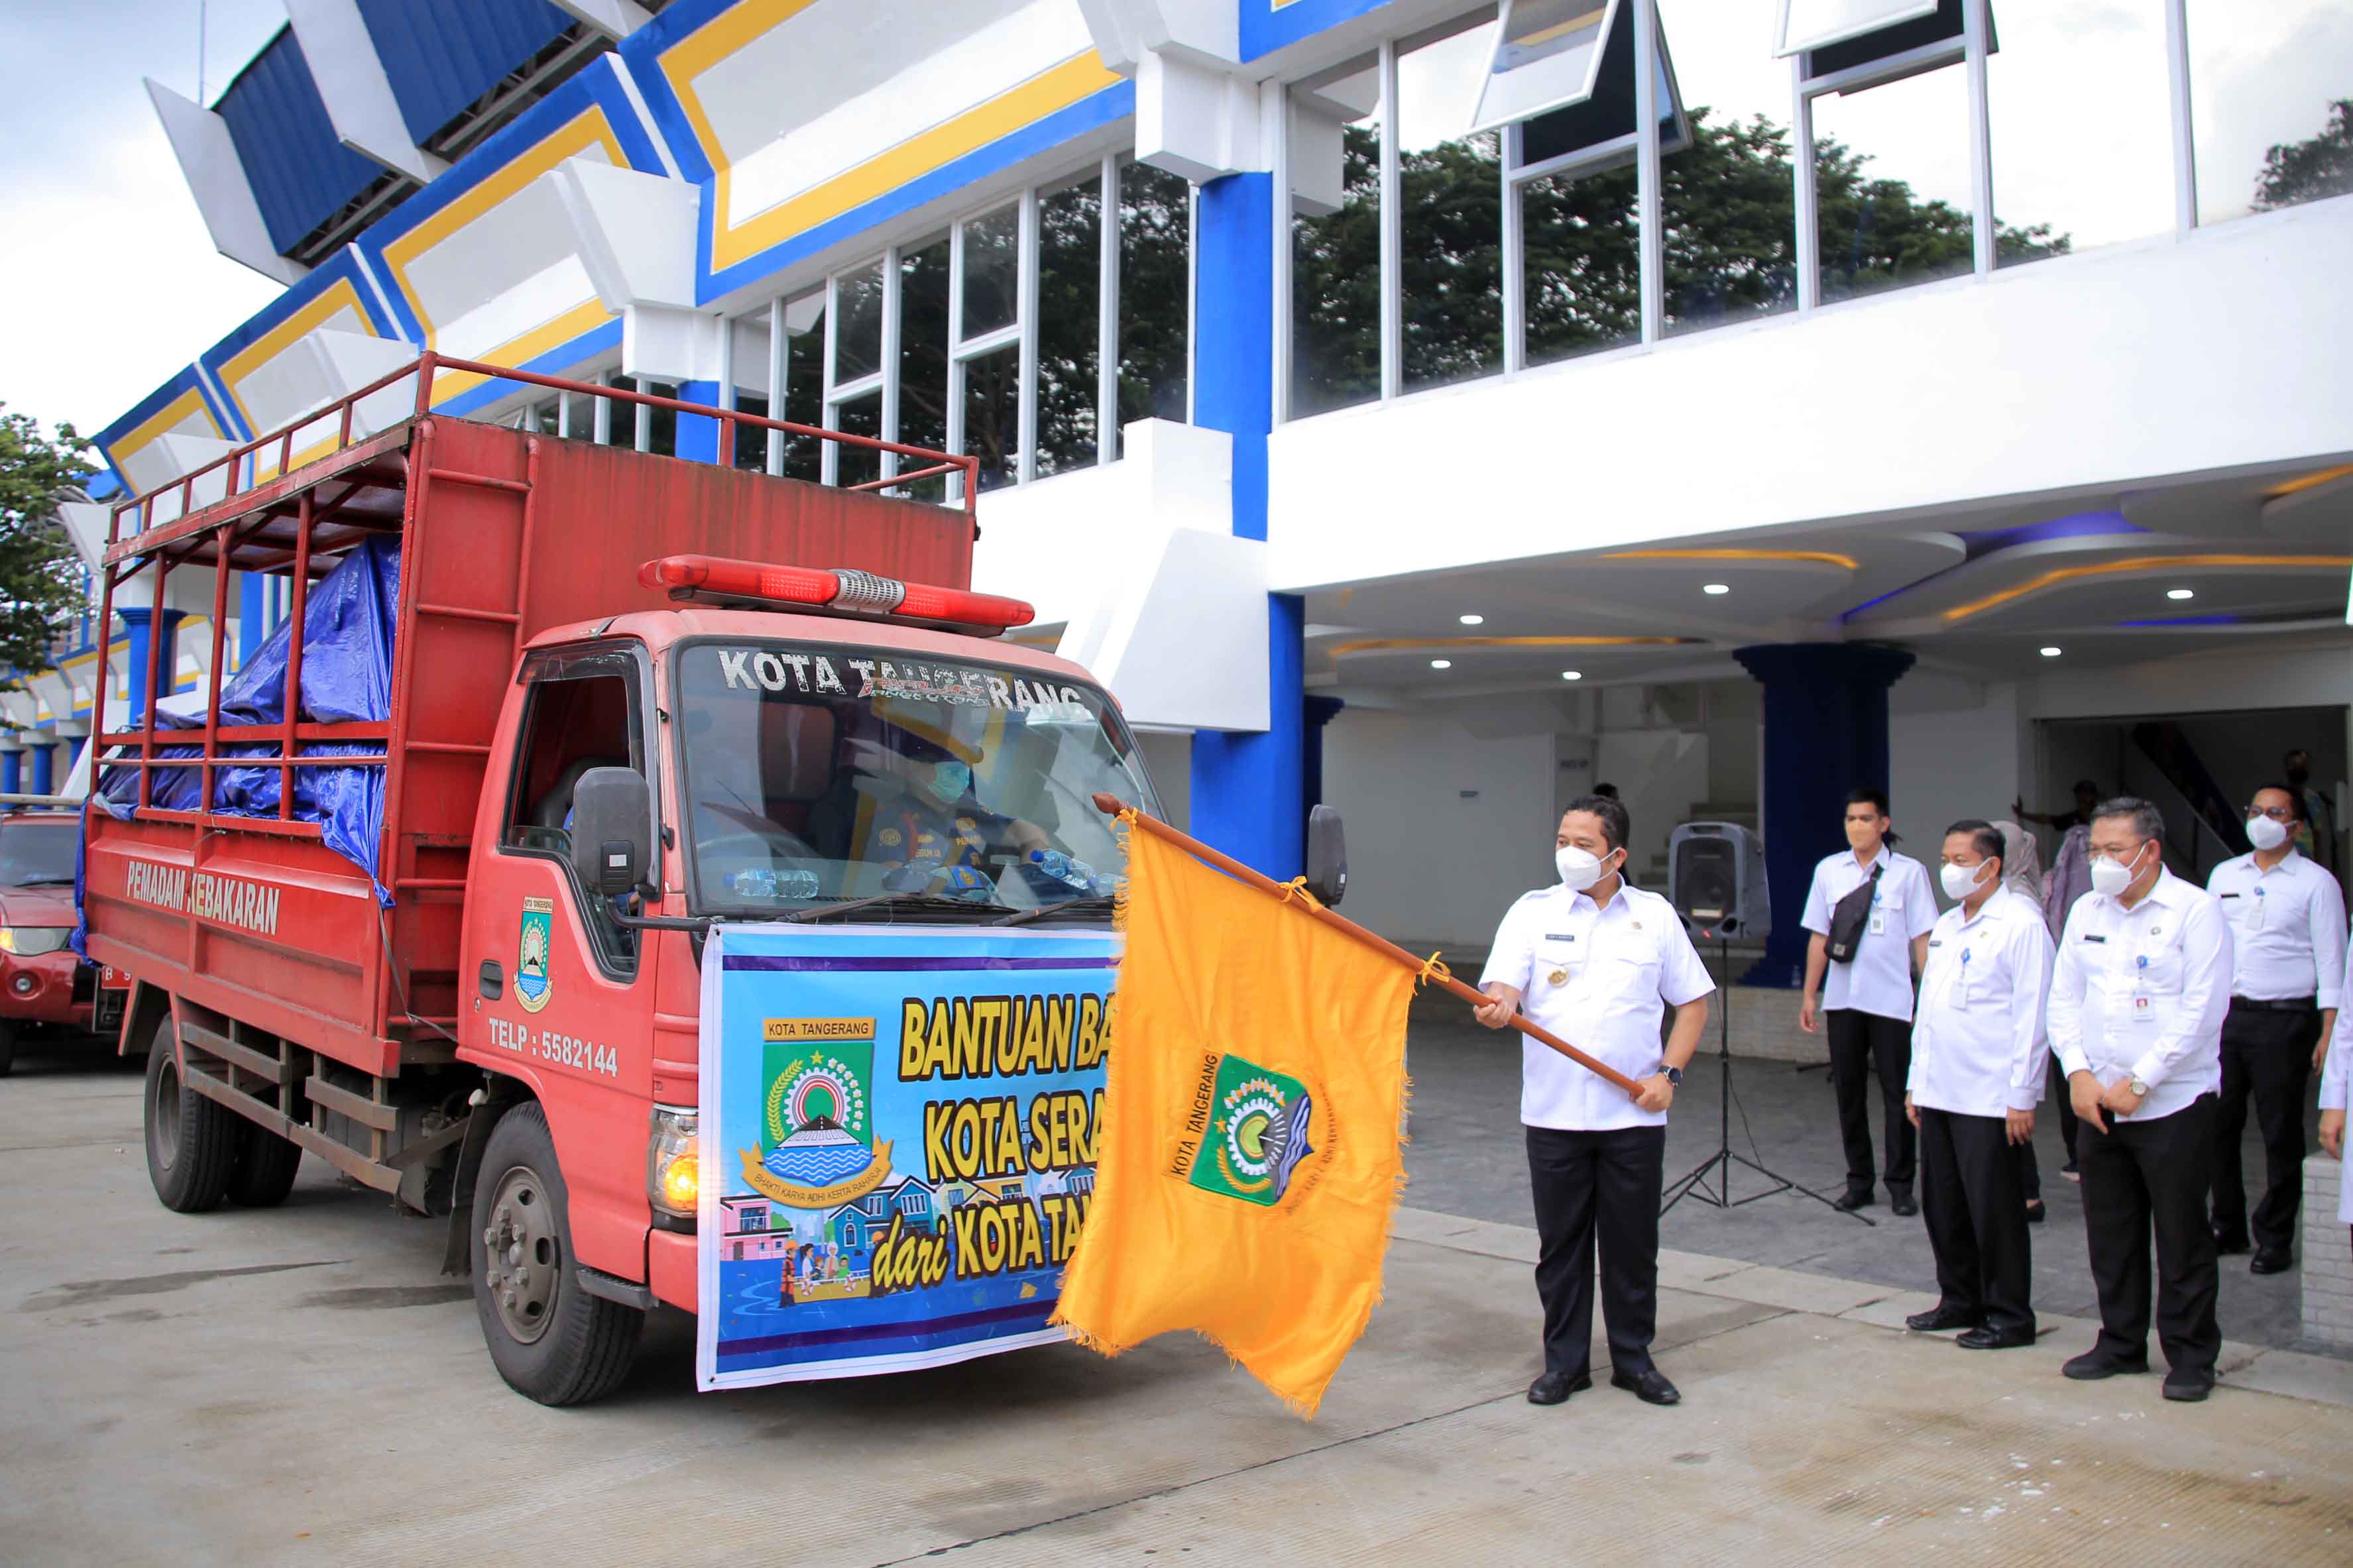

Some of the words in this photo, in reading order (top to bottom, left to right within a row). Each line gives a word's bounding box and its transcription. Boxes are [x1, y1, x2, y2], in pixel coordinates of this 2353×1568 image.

[717, 649, 847, 695] KOTA
[127, 861, 186, 911] PEMADAM
[186, 873, 280, 936] KEBAKARAN
[488, 1017, 528, 1052] TELP
[542, 1031, 618, 1078] 5582144
[768, 1023, 795, 1035] KOTA
[801, 1022, 869, 1035] TANGERANG
[898, 994, 1076, 1082] BANTUAN
[924, 1095, 1027, 1184] KOTA
[1171, 1141, 1198, 1176] KOTA
[1186, 1054, 1218, 1133] TANGERANG
[754, 1173, 781, 1192] BHAKTI
[781, 1187, 806, 1201] KARYA
[806, 1192, 826, 1202] ADHI
[827, 1187, 851, 1200] KERTA
[870, 1208, 951, 1298] dari
[953, 1200, 1047, 1282] KOTA
